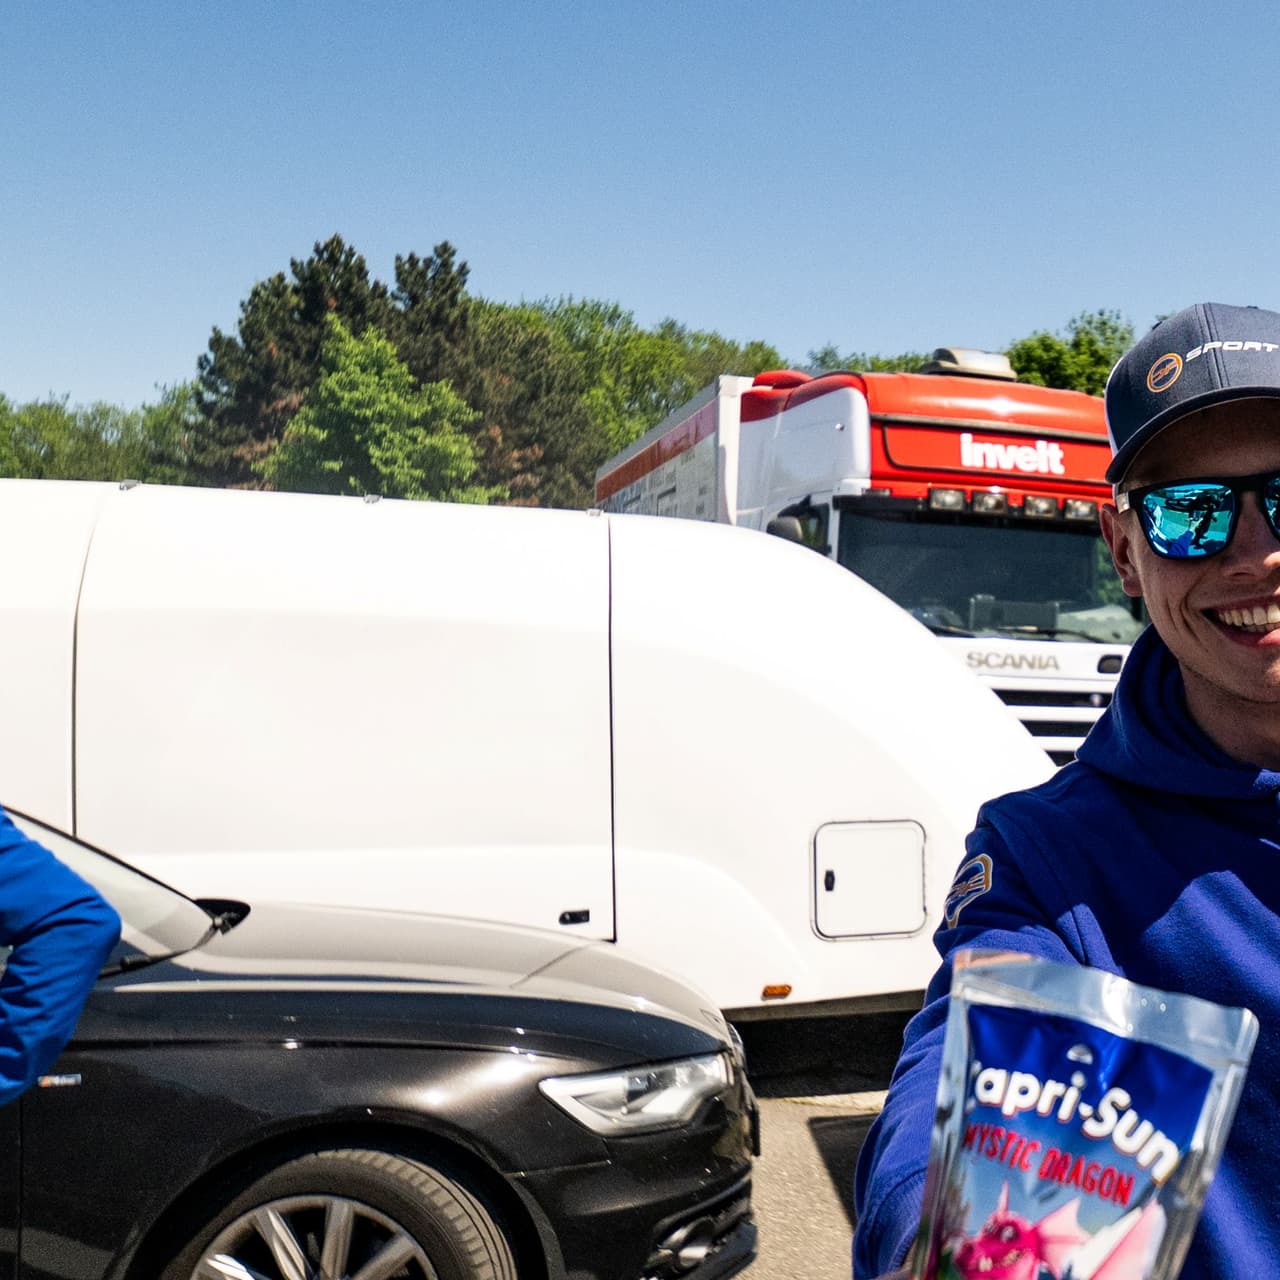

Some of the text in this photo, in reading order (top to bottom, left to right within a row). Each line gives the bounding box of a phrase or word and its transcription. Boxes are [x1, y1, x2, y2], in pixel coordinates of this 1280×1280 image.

[1185, 341, 1280, 363] SPORT
[966, 651, 1060, 671] SCANIA
[966, 1060, 1180, 1185] apri-Sun
[1038, 1147, 1136, 1208] DRAGON
